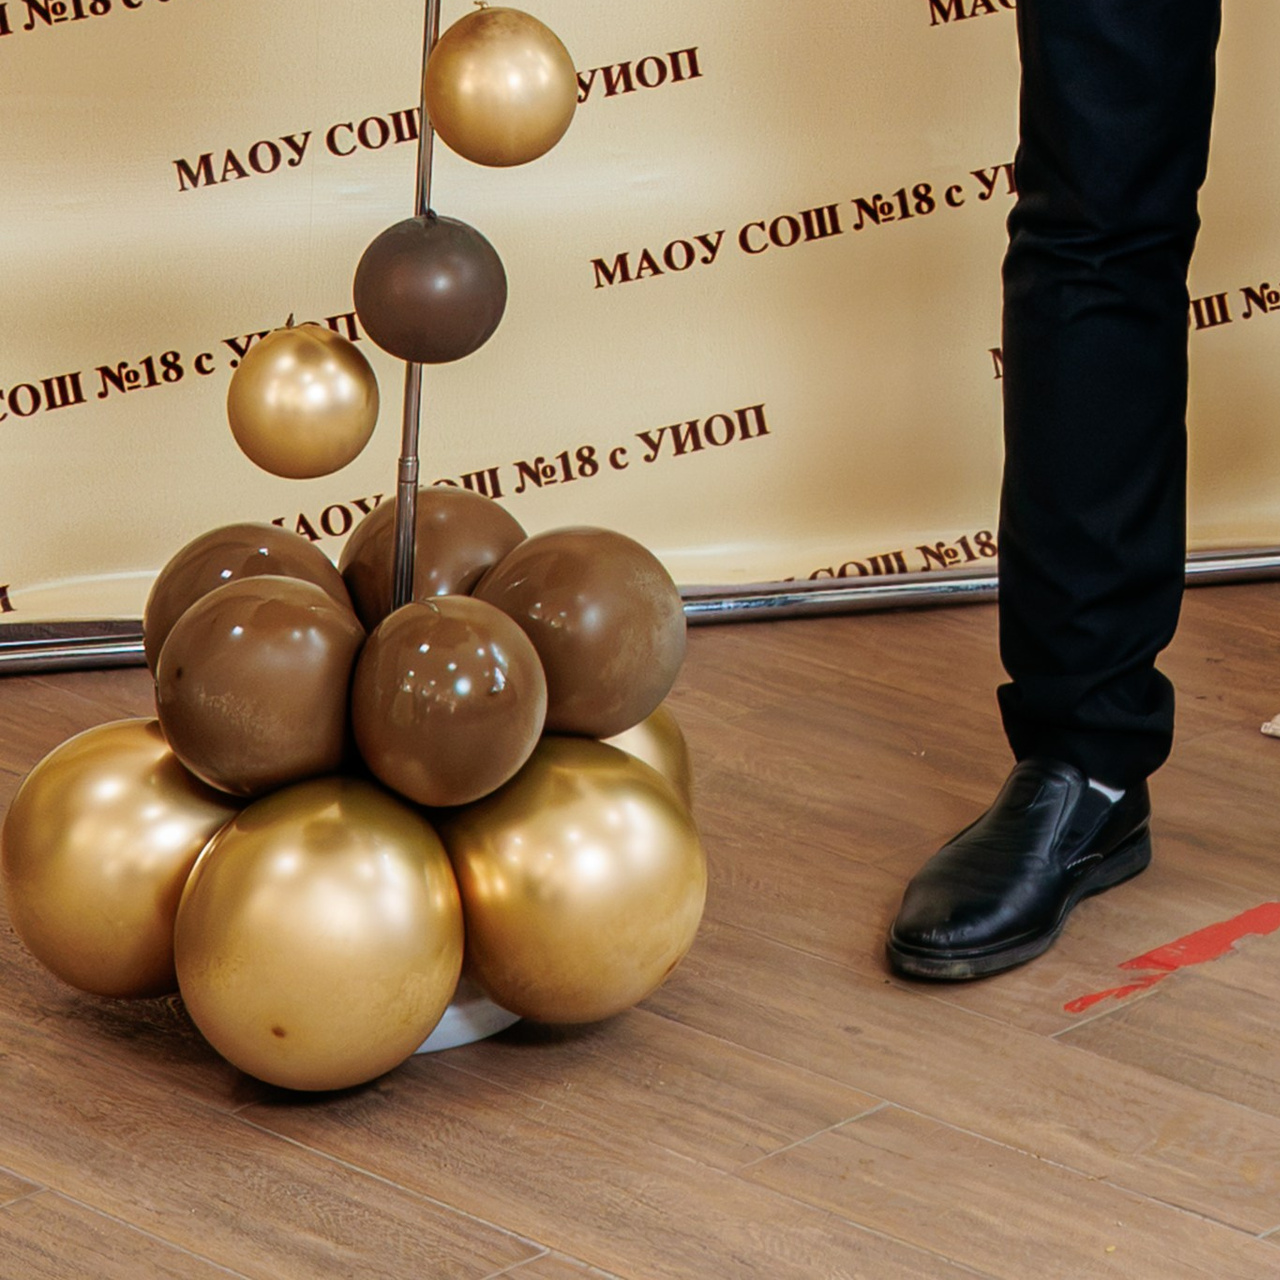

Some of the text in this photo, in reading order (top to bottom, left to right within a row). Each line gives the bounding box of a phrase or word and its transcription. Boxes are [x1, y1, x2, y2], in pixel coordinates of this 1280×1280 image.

[172, 130, 312, 192] МАОУ
[575, 46, 703, 104] УИОП
[590, 182, 966, 289] МАОУ СОШ №18 с
[95, 350, 185, 399] №18
[193, 351, 217, 377] с
[272, 493, 384, 542] АОУ
[512, 445, 599, 494] №18
[607, 445, 630, 472] с
[635, 403, 770, 463] УИОП
[917, 530, 997, 572] №18
